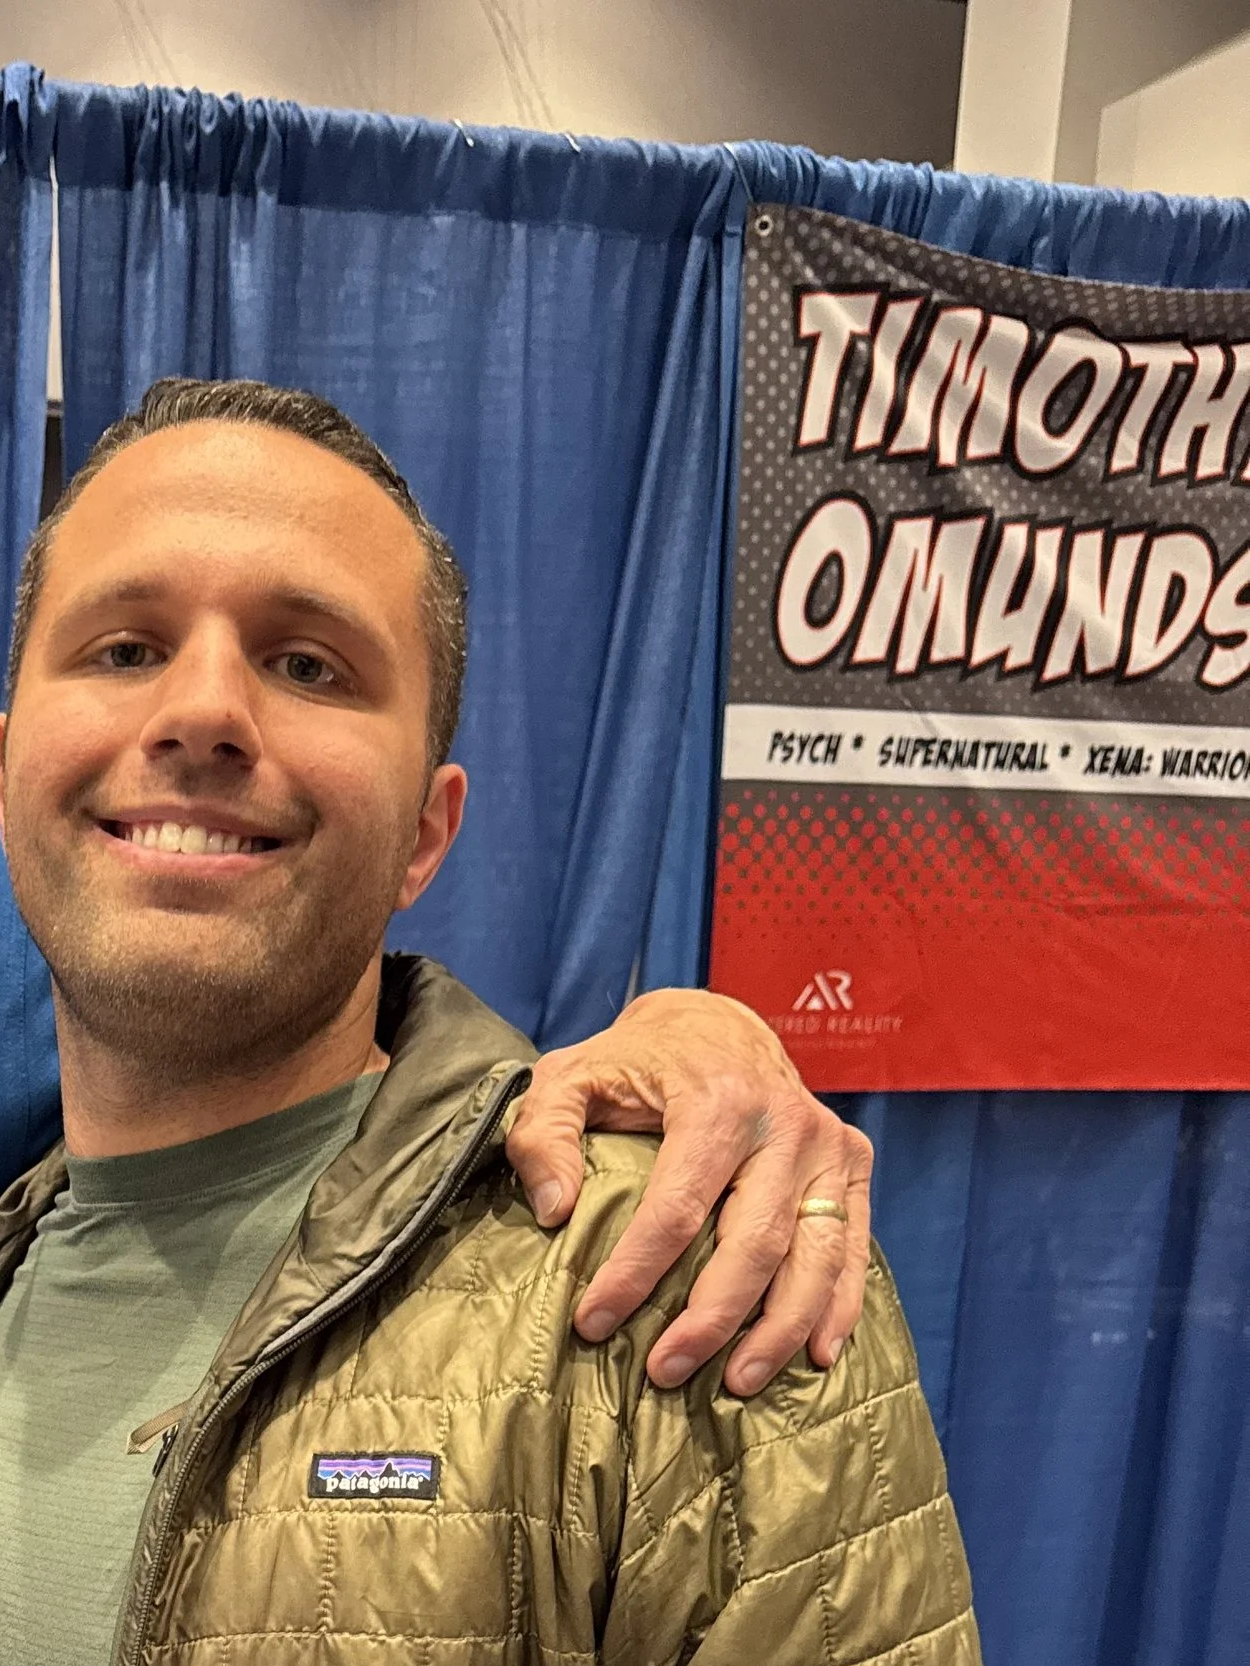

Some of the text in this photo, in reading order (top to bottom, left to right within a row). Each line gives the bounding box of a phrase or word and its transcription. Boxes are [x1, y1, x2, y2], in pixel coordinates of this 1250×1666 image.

[796, 291, 1250, 480] TIMOTH
[767, 731, 842, 765] PSYCH
[878, 737, 1048, 772] SUPERNATURAL
[1083, 745, 1154, 776] XENA:
[326, 1475, 419, 1494] patagonia
